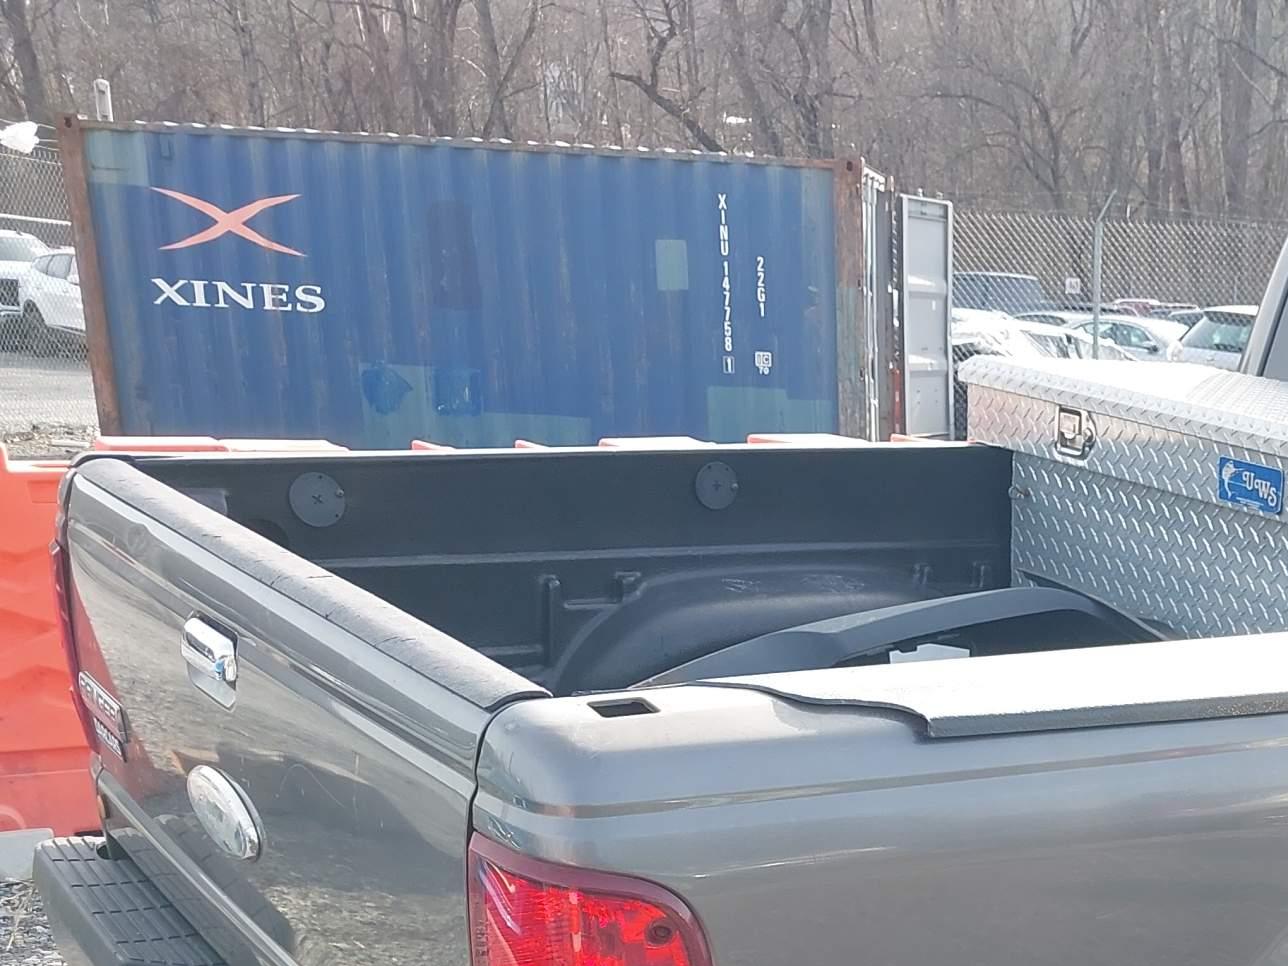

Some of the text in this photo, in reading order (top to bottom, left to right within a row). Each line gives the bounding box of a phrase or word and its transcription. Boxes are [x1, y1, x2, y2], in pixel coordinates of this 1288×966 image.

[718, 193, 729, 256] XINU
[151, 278, 325, 312] XINES
[722, 261, 733, 351] 147758
[756, 256, 766, 317] 22G1
[1242, 471, 1277, 507] UWS
